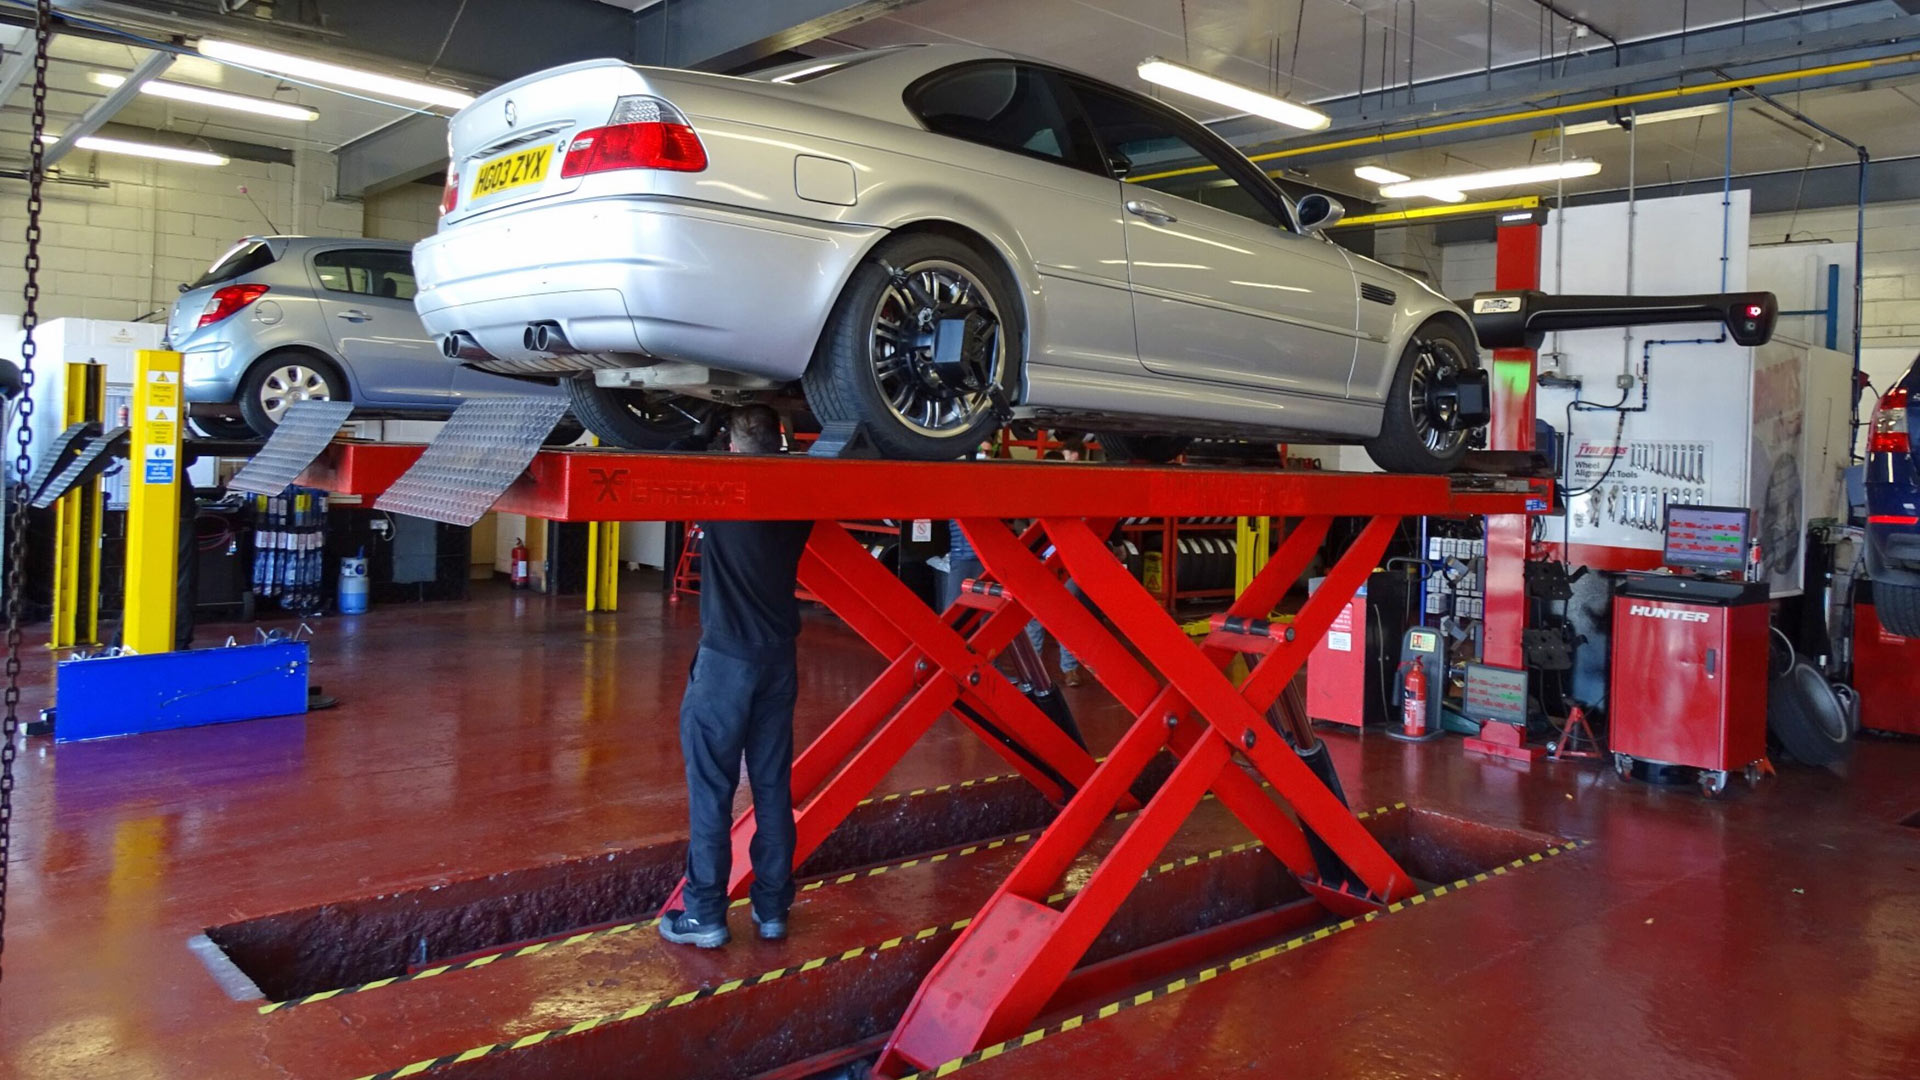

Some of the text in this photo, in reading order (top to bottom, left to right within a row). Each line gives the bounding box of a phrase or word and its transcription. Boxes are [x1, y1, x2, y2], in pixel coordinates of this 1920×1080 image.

[475, 149, 547, 194] HG03 ZYX
[1575, 461, 1600, 469] Wheel
[1617, 470, 1638, 479] Tools
[1630, 605, 1710, 623] HUNTER
